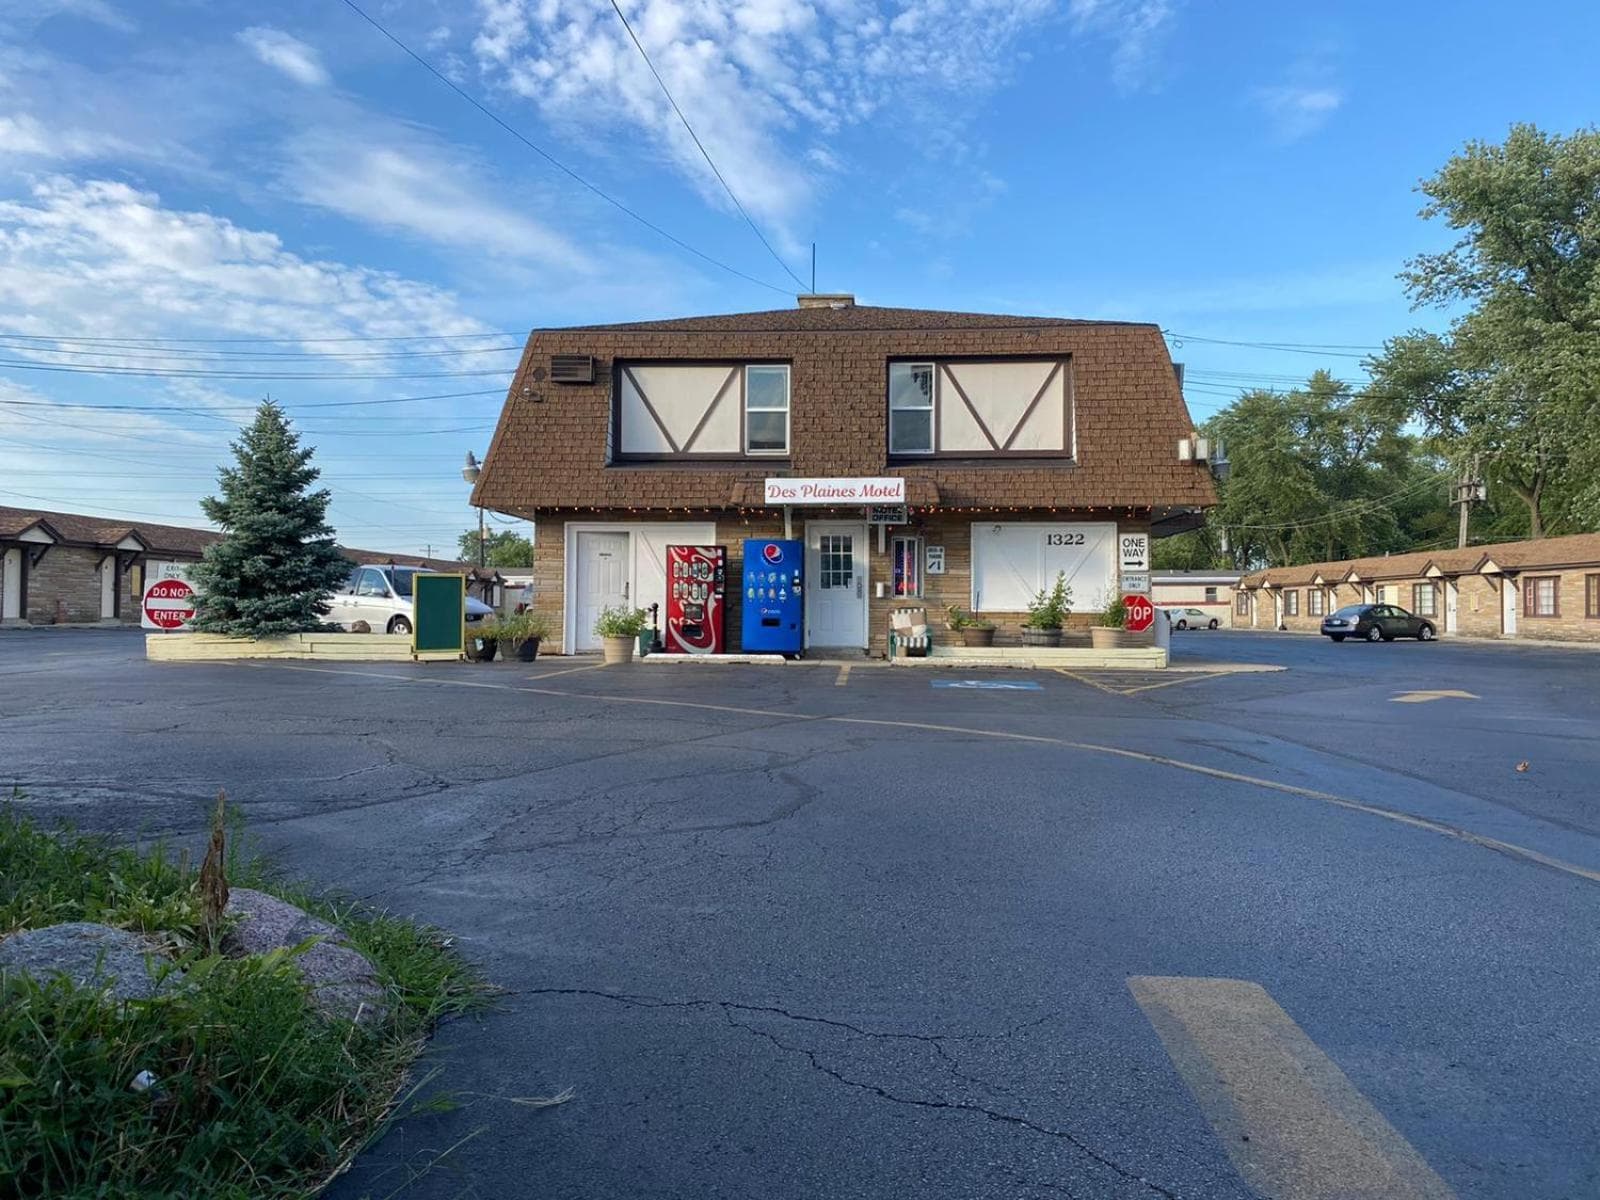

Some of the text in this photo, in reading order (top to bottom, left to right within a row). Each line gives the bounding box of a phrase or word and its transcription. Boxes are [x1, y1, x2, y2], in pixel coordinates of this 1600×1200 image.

[767, 483, 901, 498] Des Plaines Motel
[872, 514, 903, 522] OFFICE
[1047, 533, 1085, 546] 1322
[1122, 537, 1145, 549] ONE
[1122, 548, 1145, 558] WAY
[152, 587, 190, 598] DO NOT
[153, 610, 186, 621] ENTER
[1125, 606, 1152, 621] TOP
